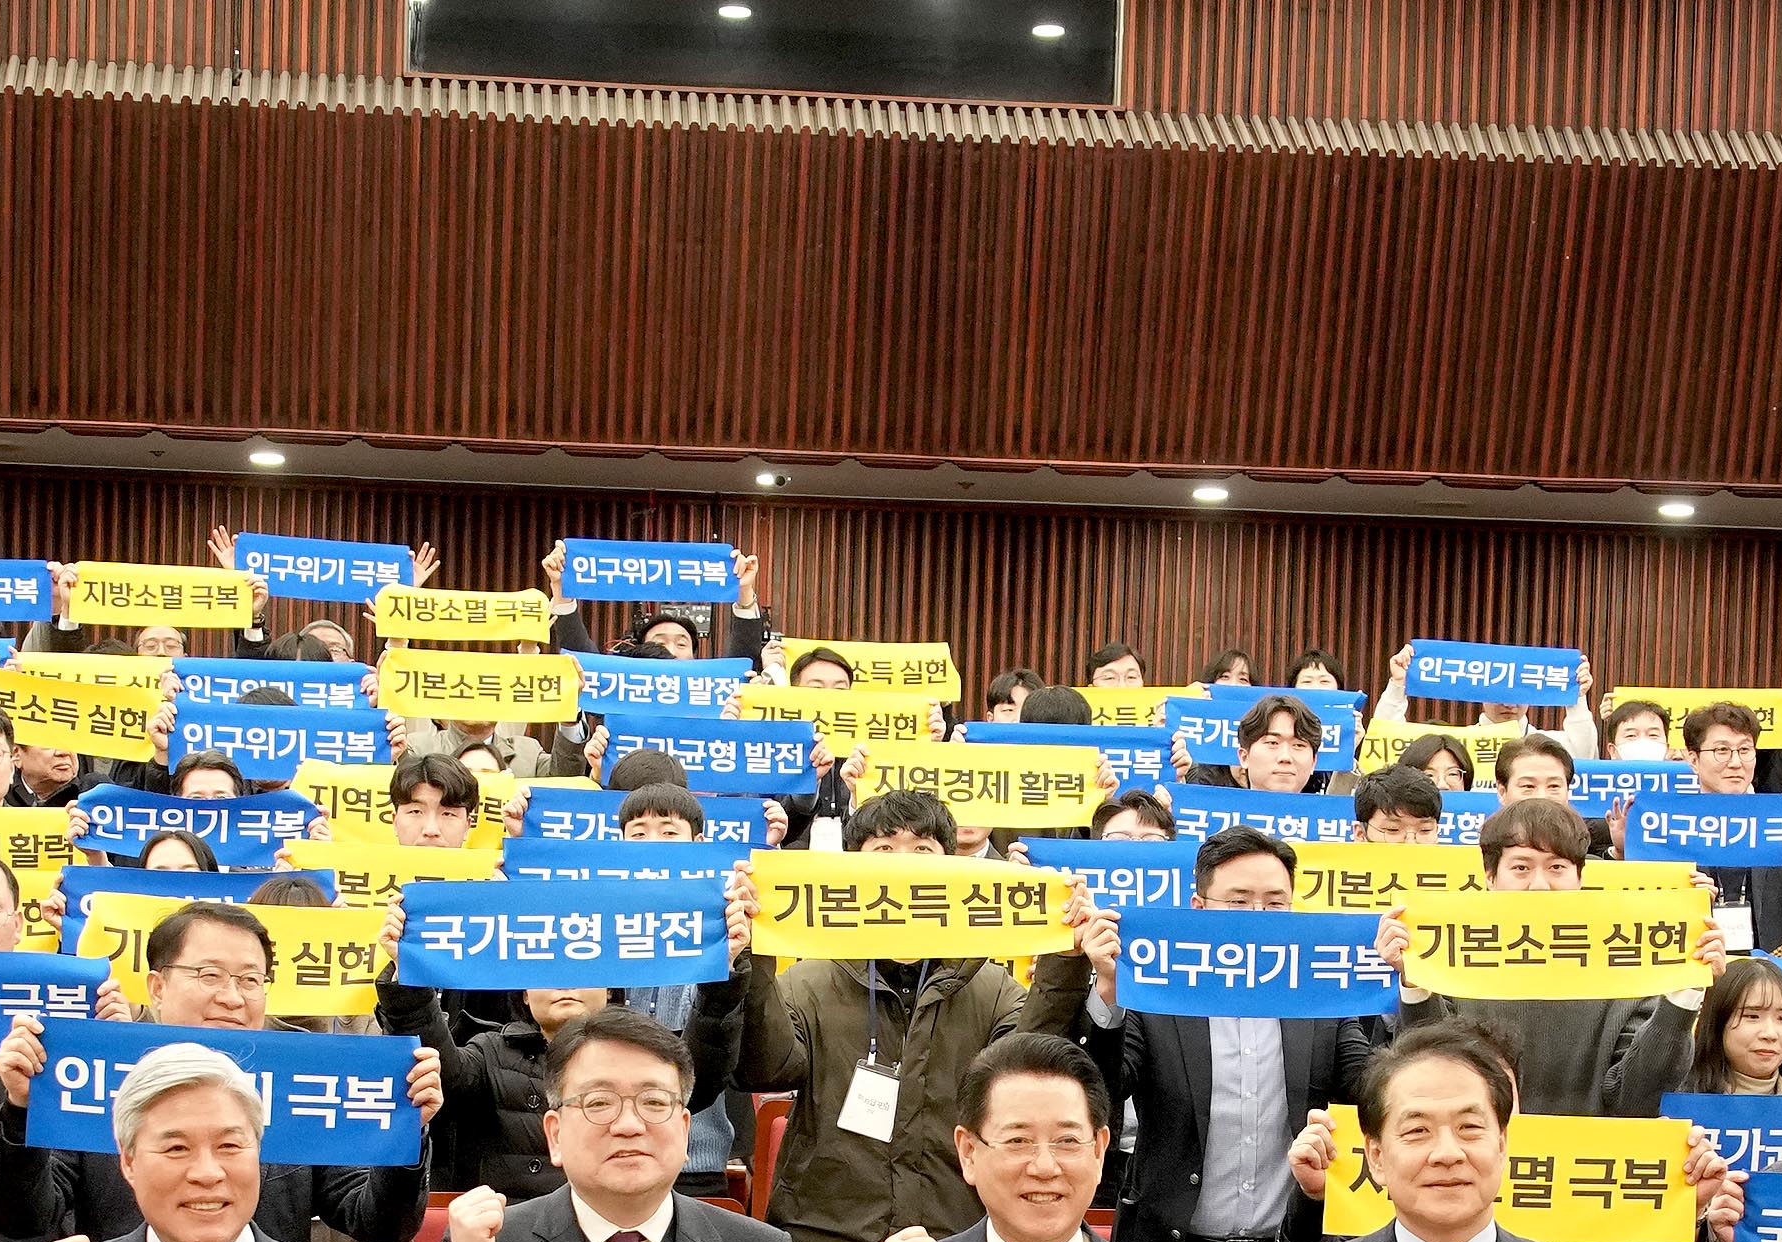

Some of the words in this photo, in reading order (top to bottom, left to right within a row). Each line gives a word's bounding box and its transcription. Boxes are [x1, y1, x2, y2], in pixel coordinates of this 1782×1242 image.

[246, 551, 344, 585] 인구위기
[350, 560, 401, 584] 극복
[573, 556, 672, 585] 인구위기
[677, 560, 728, 586] 극복
[83, 580, 183, 608] 지방소멸
[189, 585, 239, 610] 극복
[389, 595, 488, 623] 지방소멸
[494, 600, 543, 623] 극복
[395, 671, 504, 702] 기본소득
[509, 675, 562, 703] 실현
[900, 660, 948, 684] 실현
[1418, 656, 1515, 688] 인구위기
[1521, 664, 1569, 691] 극복
[301, 683, 354, 708] 극복
[580, 673, 680, 704] 국가균형
[687, 676, 740, 706] 발전
[88, 705, 148, 739] 실현
[865, 713, 918, 740] 실현
[1179, 716, 1239, 748] 국가
[183, 722, 307, 761] 인구위기
[315, 731, 376, 763] 극복
[744, 742, 804, 773] 발전
[1018, 771, 1085, 806] 활력
[236, 810, 305, 844] 극복
[1641, 811, 1757, 847] 인구위기
[9, 833, 74, 868] 활력
[773, 883, 950, 929] 기본소득
[962, 881, 1048, 927] 실현
[420, 912, 602, 960] 국가균형
[615, 910, 705, 960] 발전
[1417, 923, 1587, 967] 기본소득
[1603, 922, 1686, 967] 실현
[292, 943, 376, 986] 실현
[1129, 937, 1298, 988] 인구위기
[1310, 944, 1393, 989] 극복
[0, 983, 91, 1019] 극복
[288, 1072, 396, 1129] 극복
[1569, 1158, 1669, 1210] 극복
